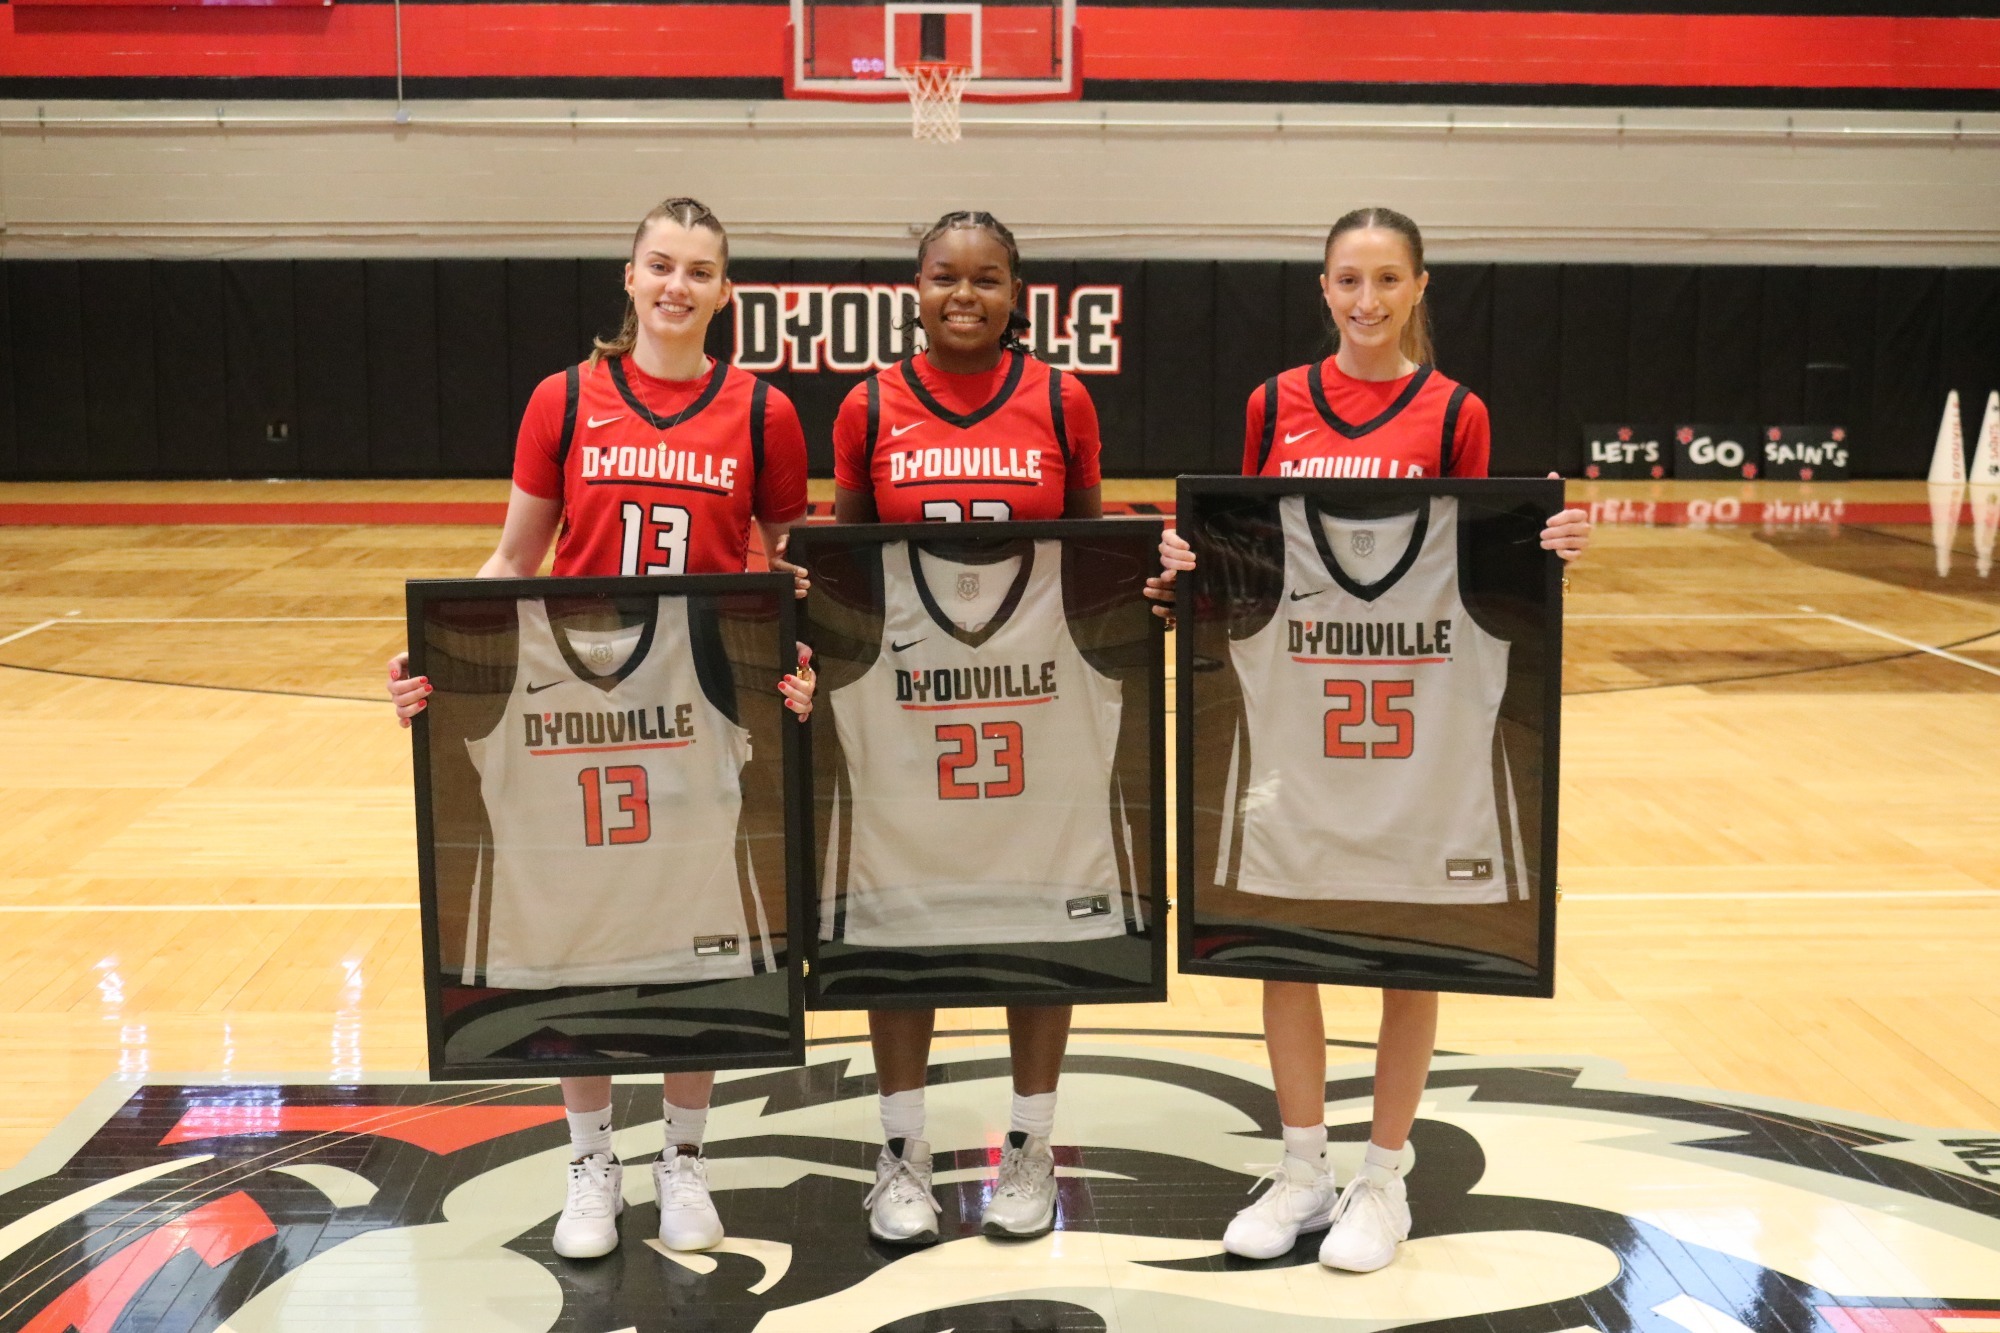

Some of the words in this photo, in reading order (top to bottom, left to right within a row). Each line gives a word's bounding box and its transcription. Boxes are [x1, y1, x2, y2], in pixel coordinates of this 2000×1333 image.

[1591, 440, 1660, 464] LET'S
[1689, 436, 1744, 467] GO
[1764, 441, 1849, 467] SAINTS
[620, 501, 692, 576] 13
[1324, 679, 1414, 759] 25
[935, 720, 1025, 800] 23
[578, 765, 651, 847] 13
[1477, 865, 1487, 874] M
[1096, 901, 1103, 909] L
[724, 940, 733, 949] M
